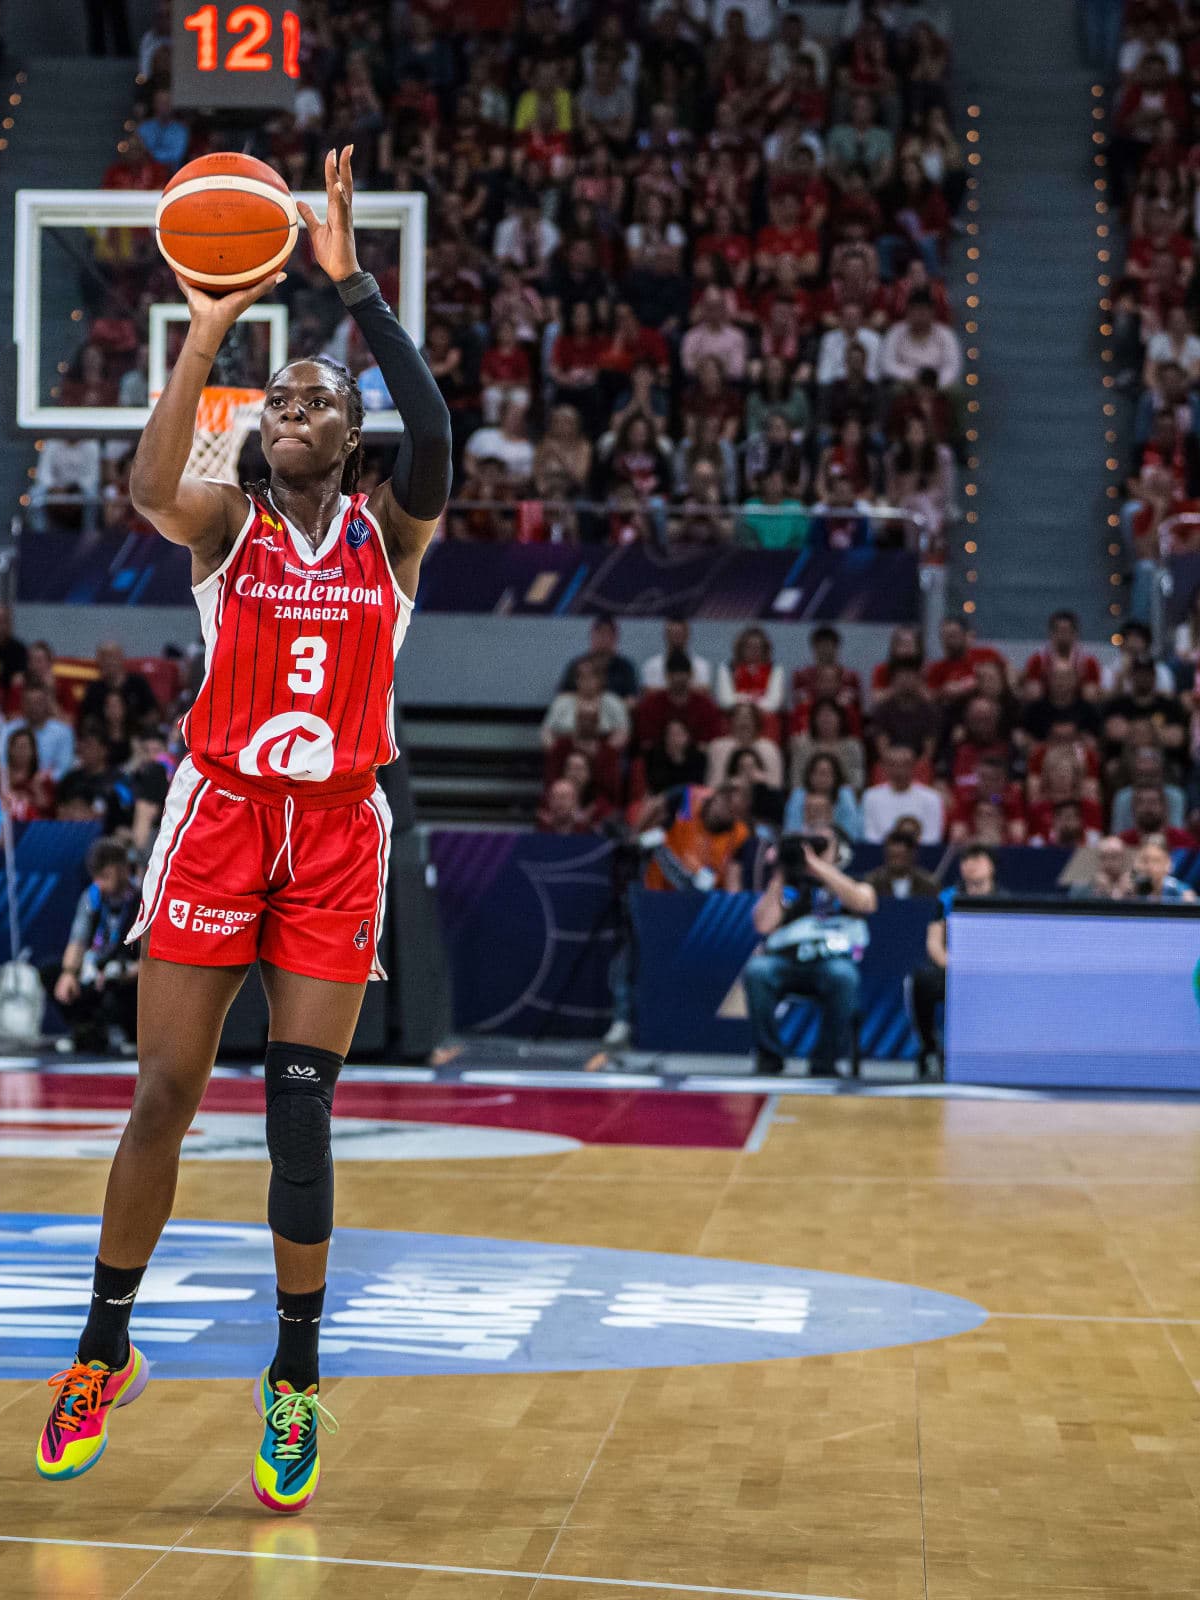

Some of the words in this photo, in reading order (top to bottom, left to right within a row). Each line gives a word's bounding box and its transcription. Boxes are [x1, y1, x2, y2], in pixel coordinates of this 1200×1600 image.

[235, 573, 383, 606] Casademont
[273, 605, 349, 621] ZARAGOZA
[287, 636, 327, 695] 3
